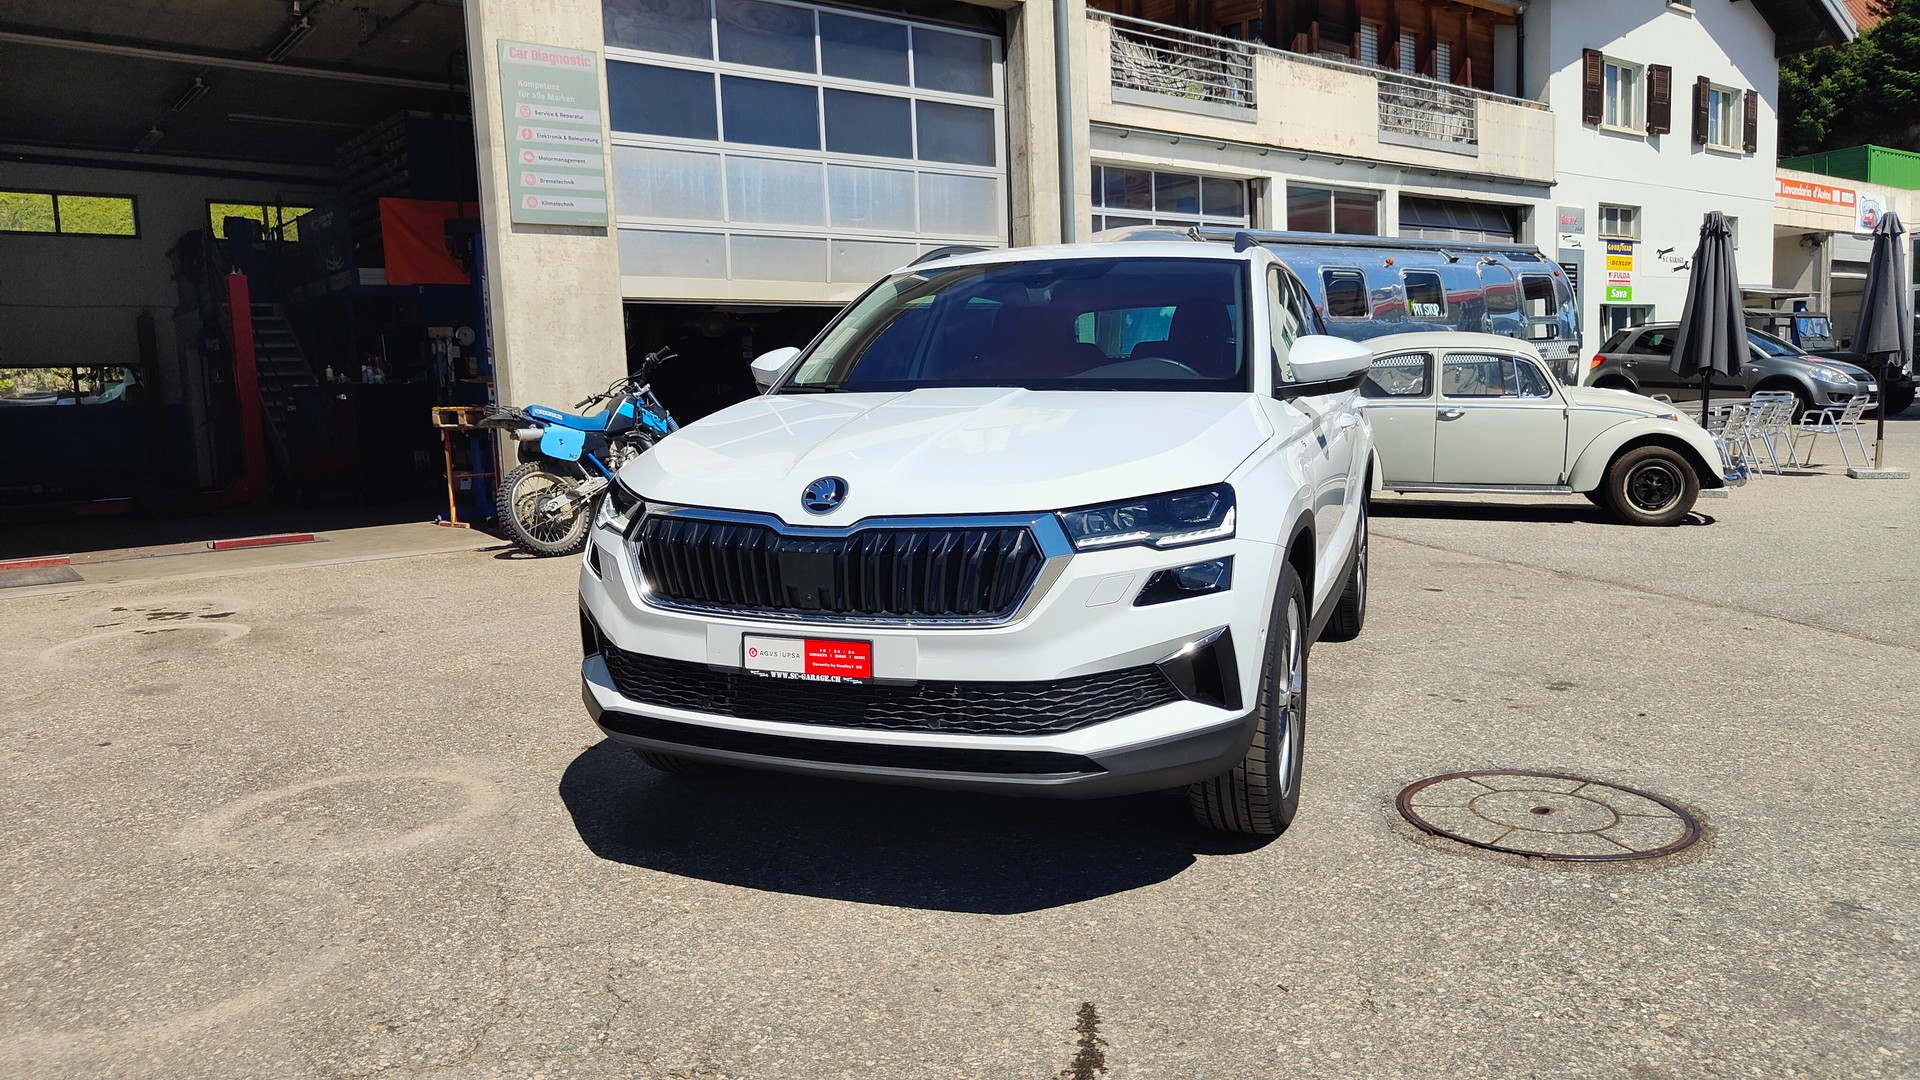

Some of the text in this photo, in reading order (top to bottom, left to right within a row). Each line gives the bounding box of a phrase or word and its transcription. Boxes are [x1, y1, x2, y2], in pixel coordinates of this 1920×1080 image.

[509, 47, 591, 67] Car Diagnostic
[518, 80, 560, 91] Kompetenz
[518, 90, 575, 103] für alle Marken
[536, 132, 562, 140] Elektronik
[568, 135, 599, 144] Beleuchtung
[538, 155, 586, 164] Motormanagement
[540, 177, 575, 185] Bremstechnik
[541, 200, 575, 208] Klimatechnik
[1611, 288, 1627, 299] Sava
[1412, 303, 1440, 317] PIT STOP
[770, 670, 841, 683] WWW.SC-GARAGE.CH
